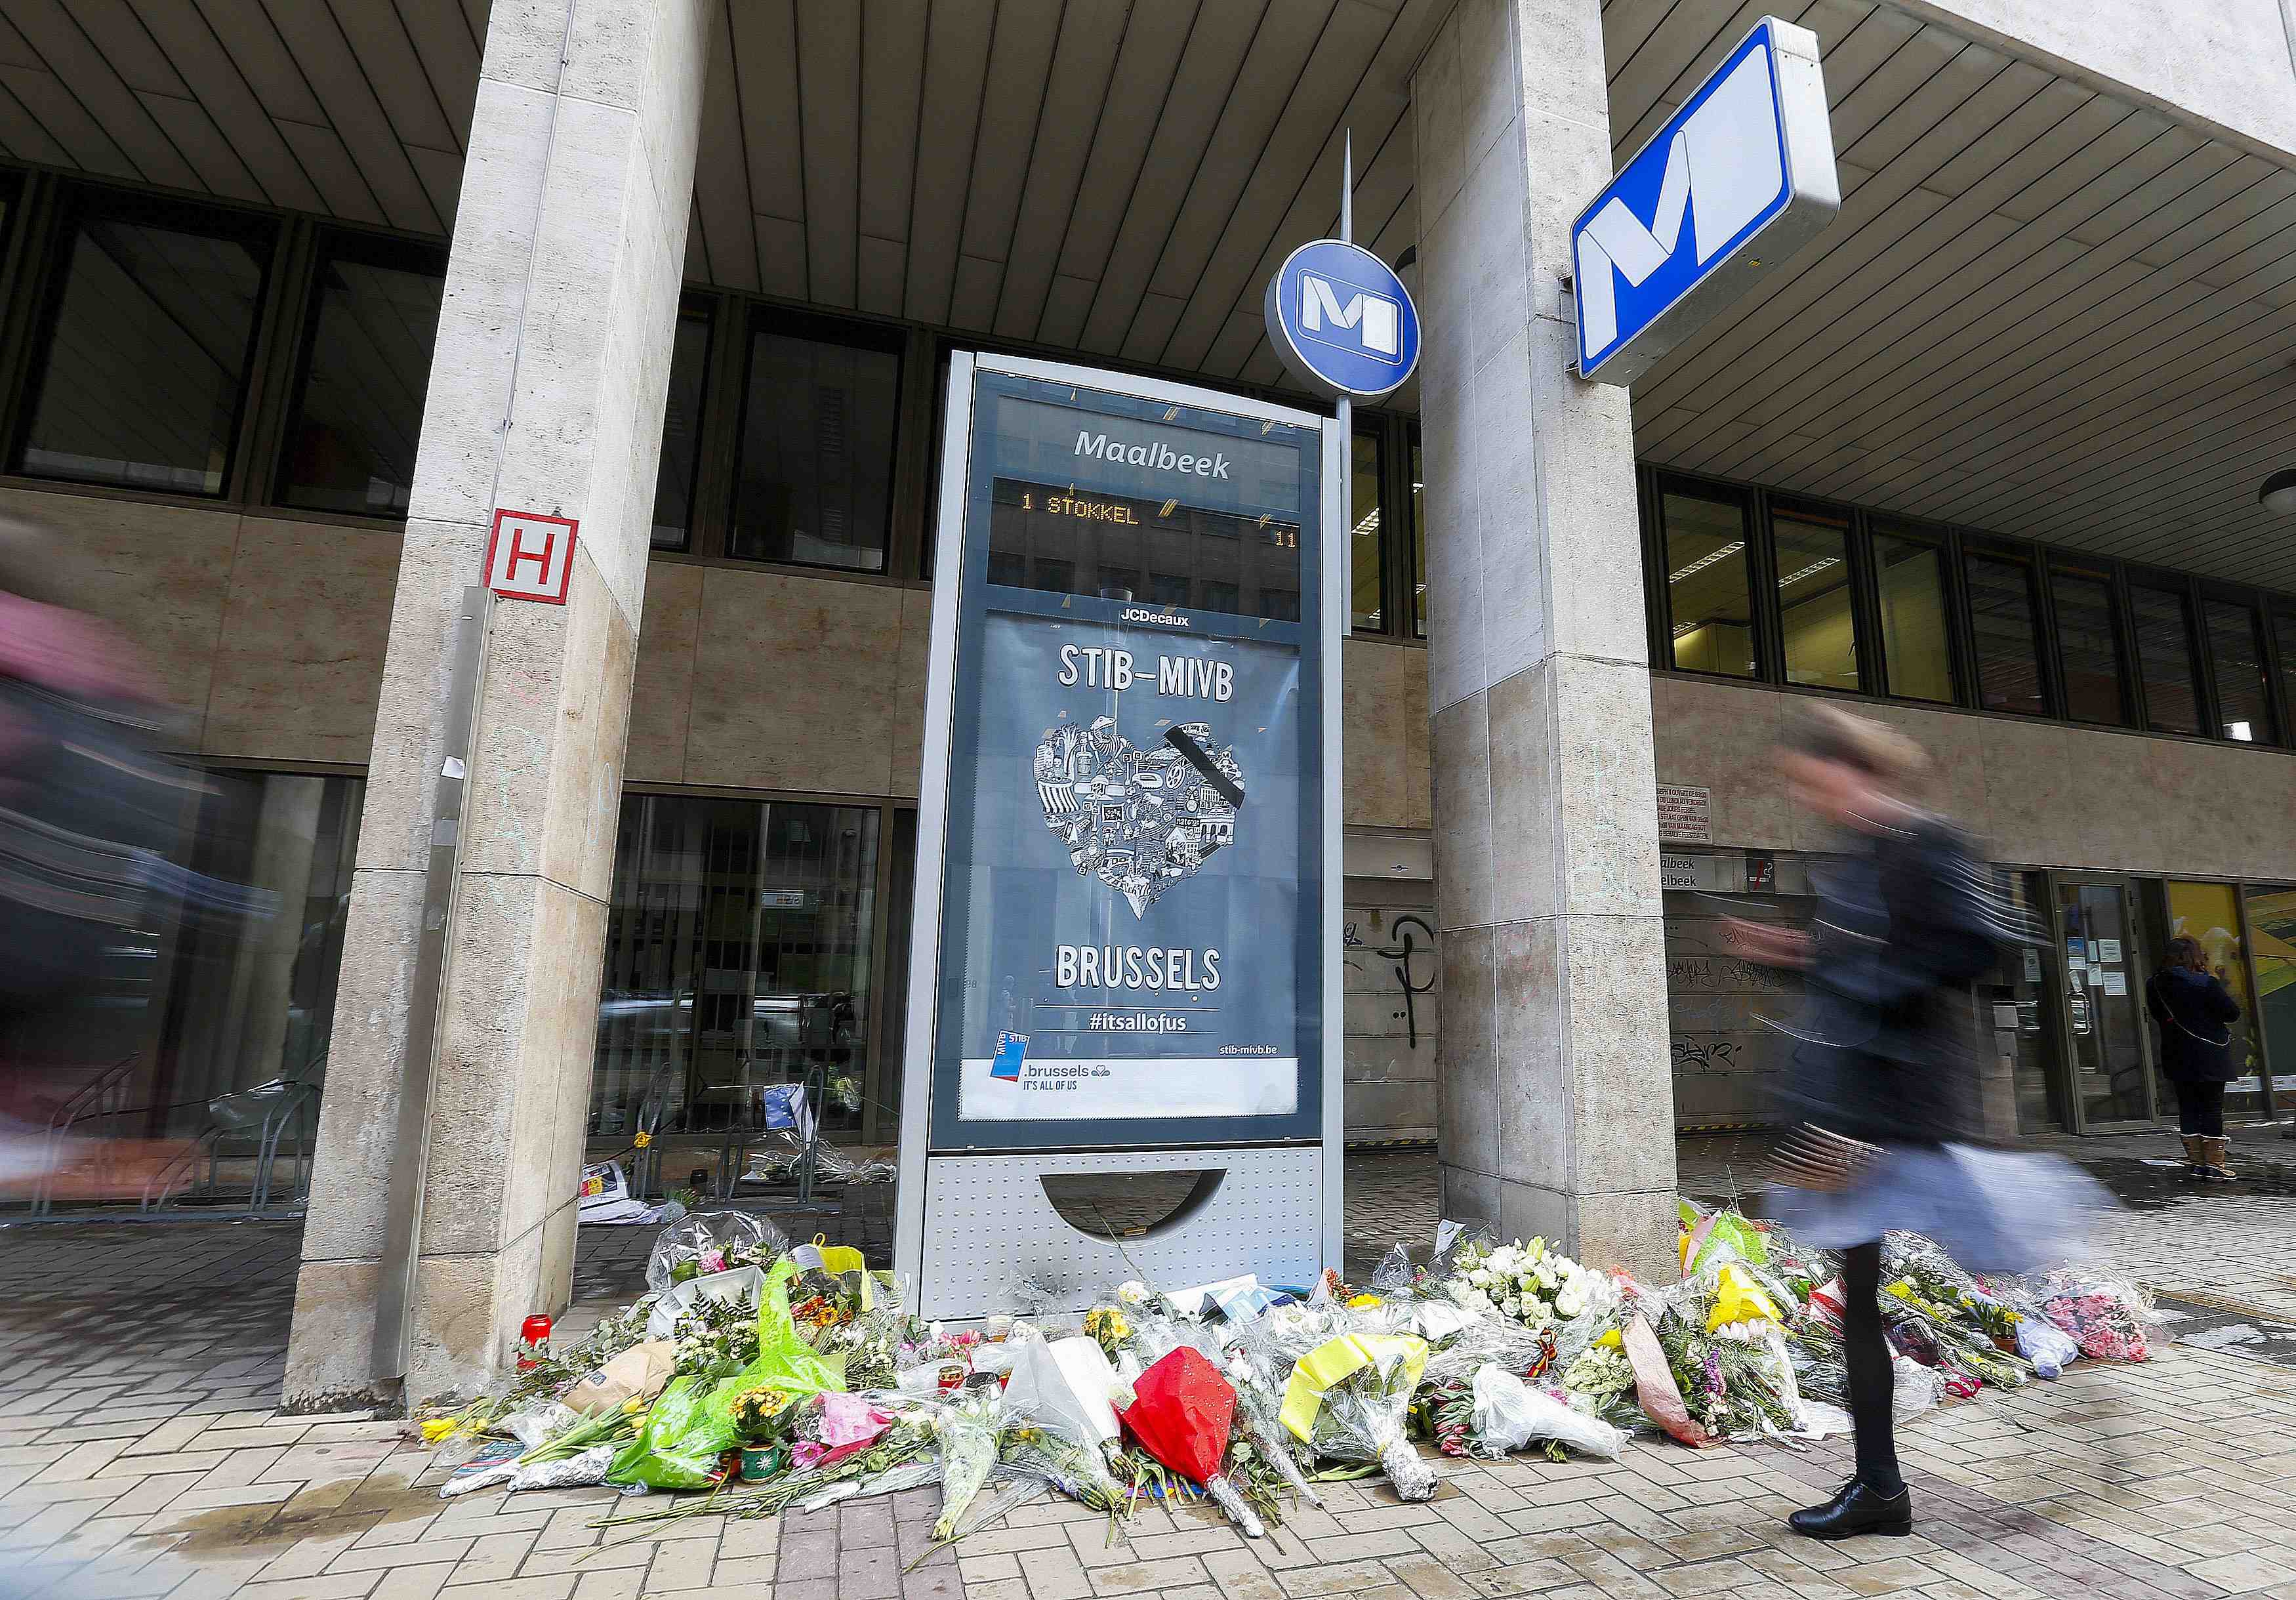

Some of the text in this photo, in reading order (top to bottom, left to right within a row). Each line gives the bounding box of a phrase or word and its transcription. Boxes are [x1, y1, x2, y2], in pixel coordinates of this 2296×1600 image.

[1074, 430, 1231, 480] Maalbeek
[1022, 493, 1296, 548] 1 STOKKEL 11
[506, 527, 556, 585] H
[1120, 607, 1190, 627] JCDecaux
[1661, 857, 1695, 869] albeek
[1661, 874, 1697, 887] elbeek
[1056, 944, 1221, 991] BRUSSELS
[1089, 1012, 1187, 1035] #itsallofus
[996, 1033, 1006, 1056] MIVB
[1008, 1033, 1027, 1042] STIB
[1220, 1044, 1278, 1055] stib-mivb.be
[1040, 1080, 1054, 1090] ALL
[1056, 1080, 1065, 1090] OF
[1067, 1080, 1077, 1090] US
